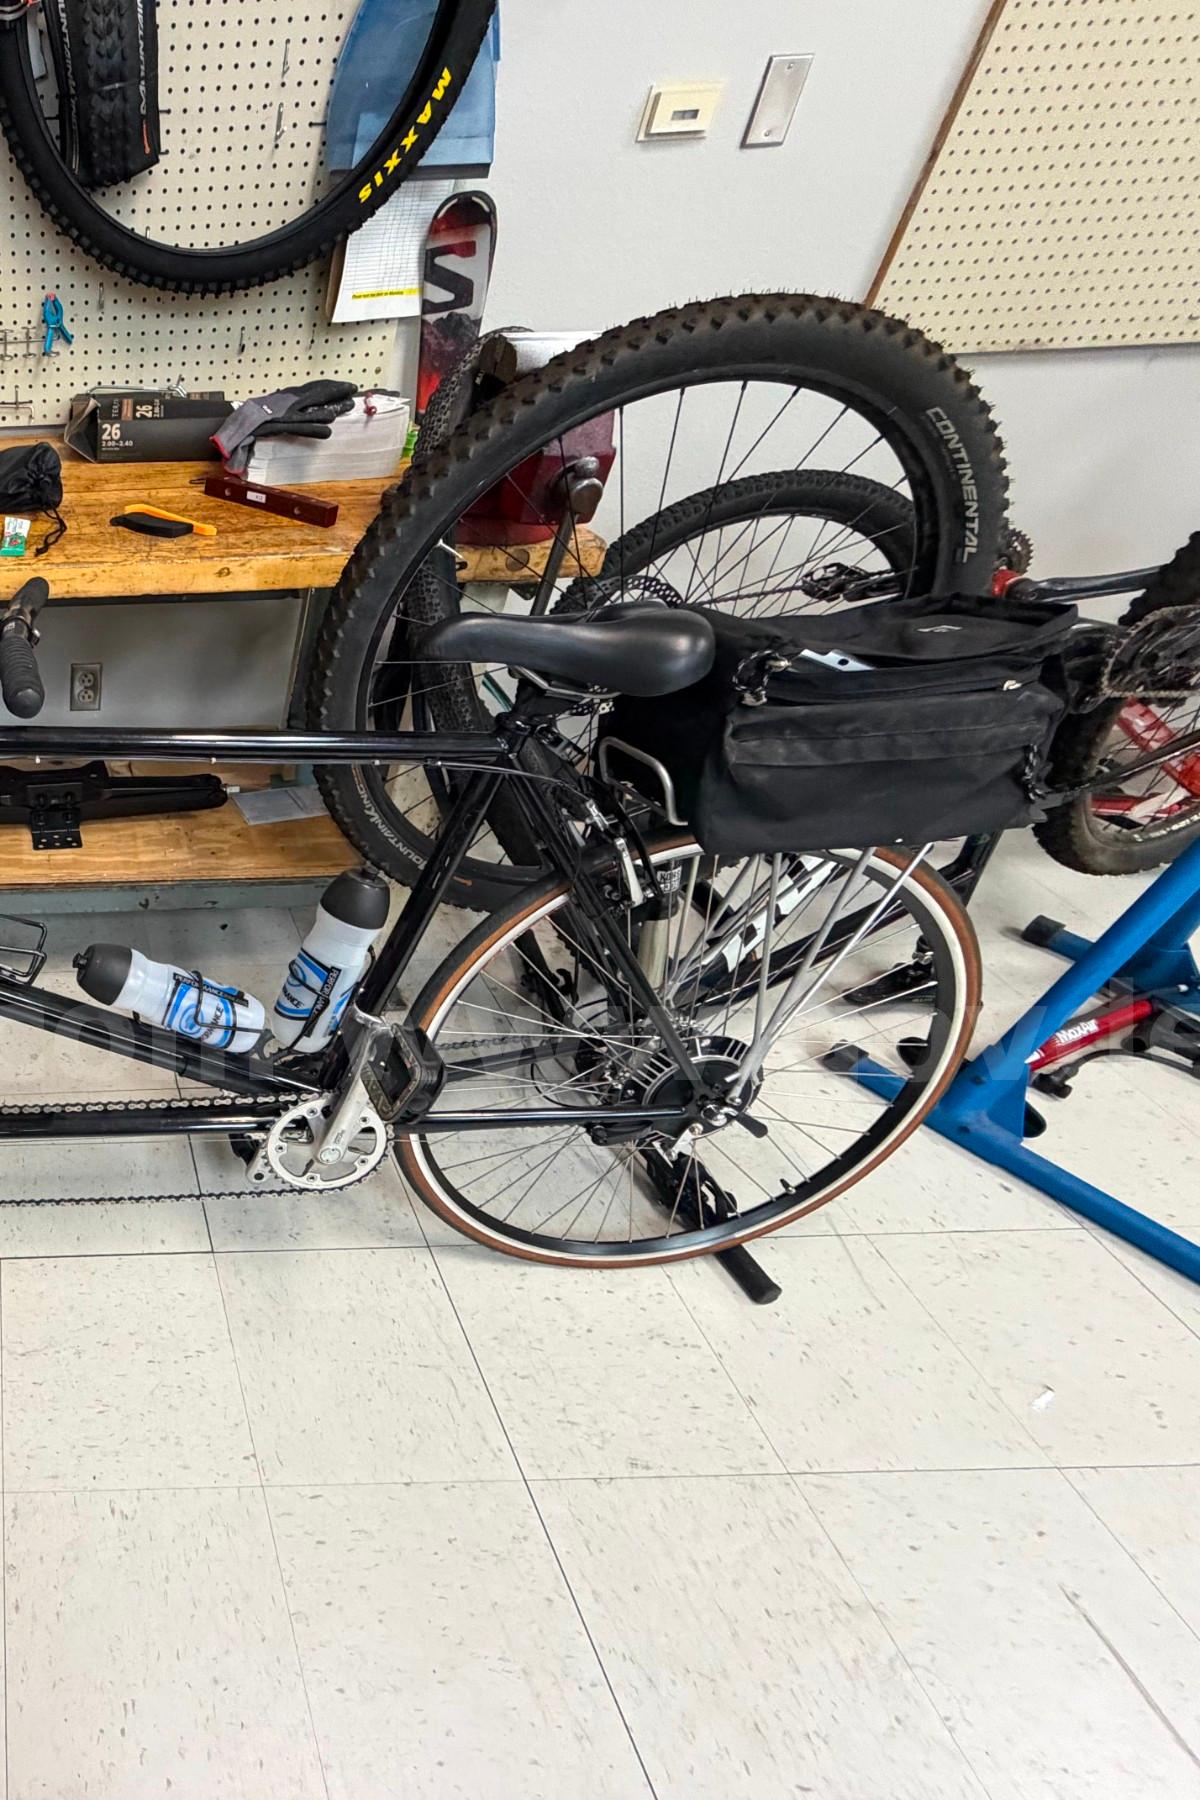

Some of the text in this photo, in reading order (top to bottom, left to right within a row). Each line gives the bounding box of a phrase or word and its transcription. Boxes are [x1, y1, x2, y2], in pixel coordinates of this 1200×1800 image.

[358, 66, 453, 204] MAXXIS
[135, 404, 153, 418] 26
[101, 423, 121, 441] 26
[925, 406, 980, 564] CONTINENTAL
[1055, 1018, 1100, 1045] MaxAir
